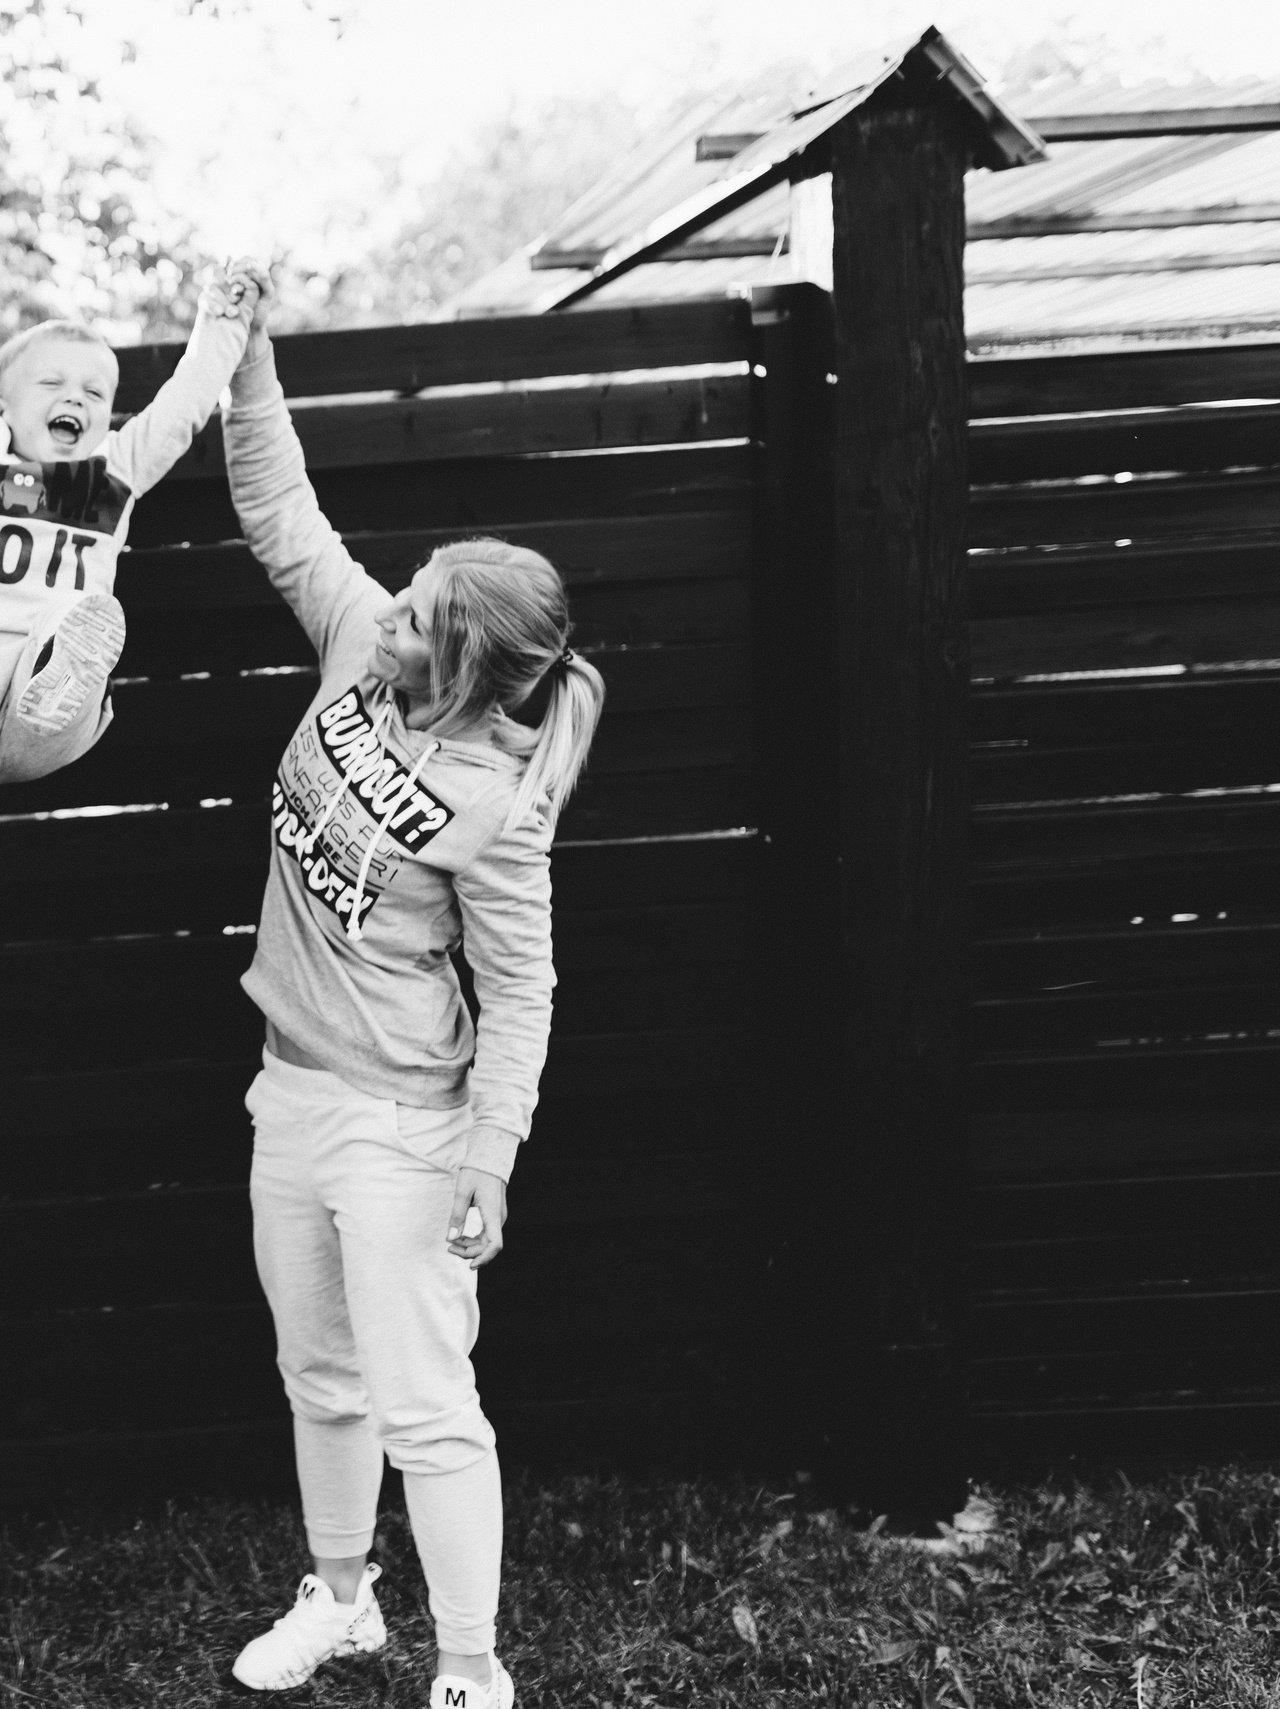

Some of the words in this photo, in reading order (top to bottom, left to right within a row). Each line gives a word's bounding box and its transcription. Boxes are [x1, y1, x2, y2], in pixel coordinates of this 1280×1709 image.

[45, 529, 97, 591] IT
[300, 725, 318, 761] IST
[317, 771, 357, 820] WAS
[320, 692, 447, 843] BURNOUT?
[289, 791, 310, 818] ICH
[445, 1687, 466, 1709] M
